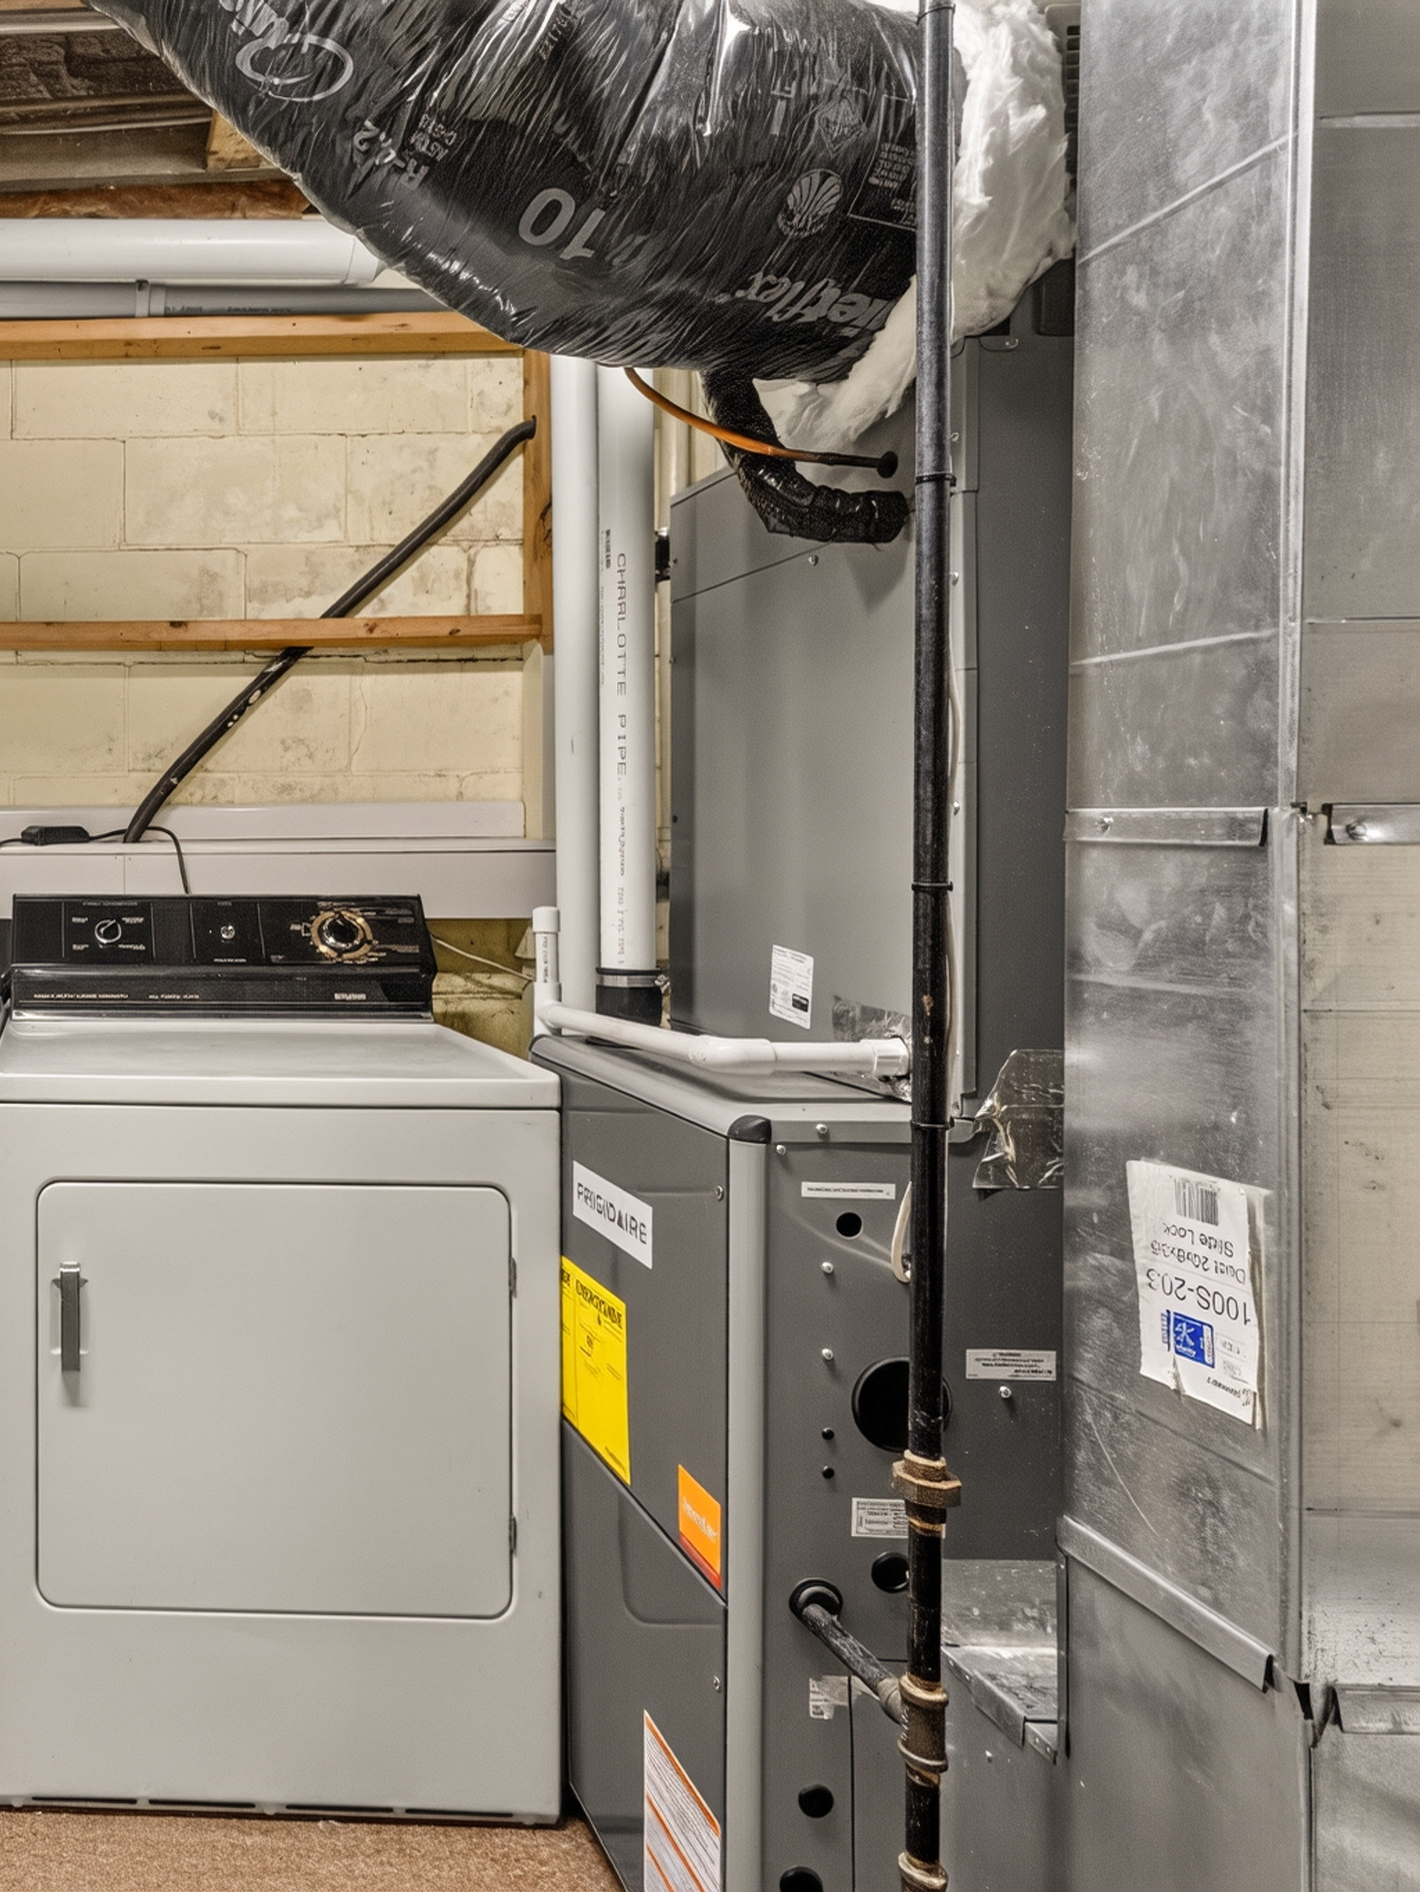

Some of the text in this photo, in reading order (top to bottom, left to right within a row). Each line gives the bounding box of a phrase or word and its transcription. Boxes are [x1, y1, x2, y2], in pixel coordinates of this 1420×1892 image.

[518, 188, 606, 261] 10
[616, 552, 627, 776] CHARLOTTE PIPE
[576, 1182, 648, 1245] FRIGIDAIRE
[1199, 1233, 1234, 1258] Slide
